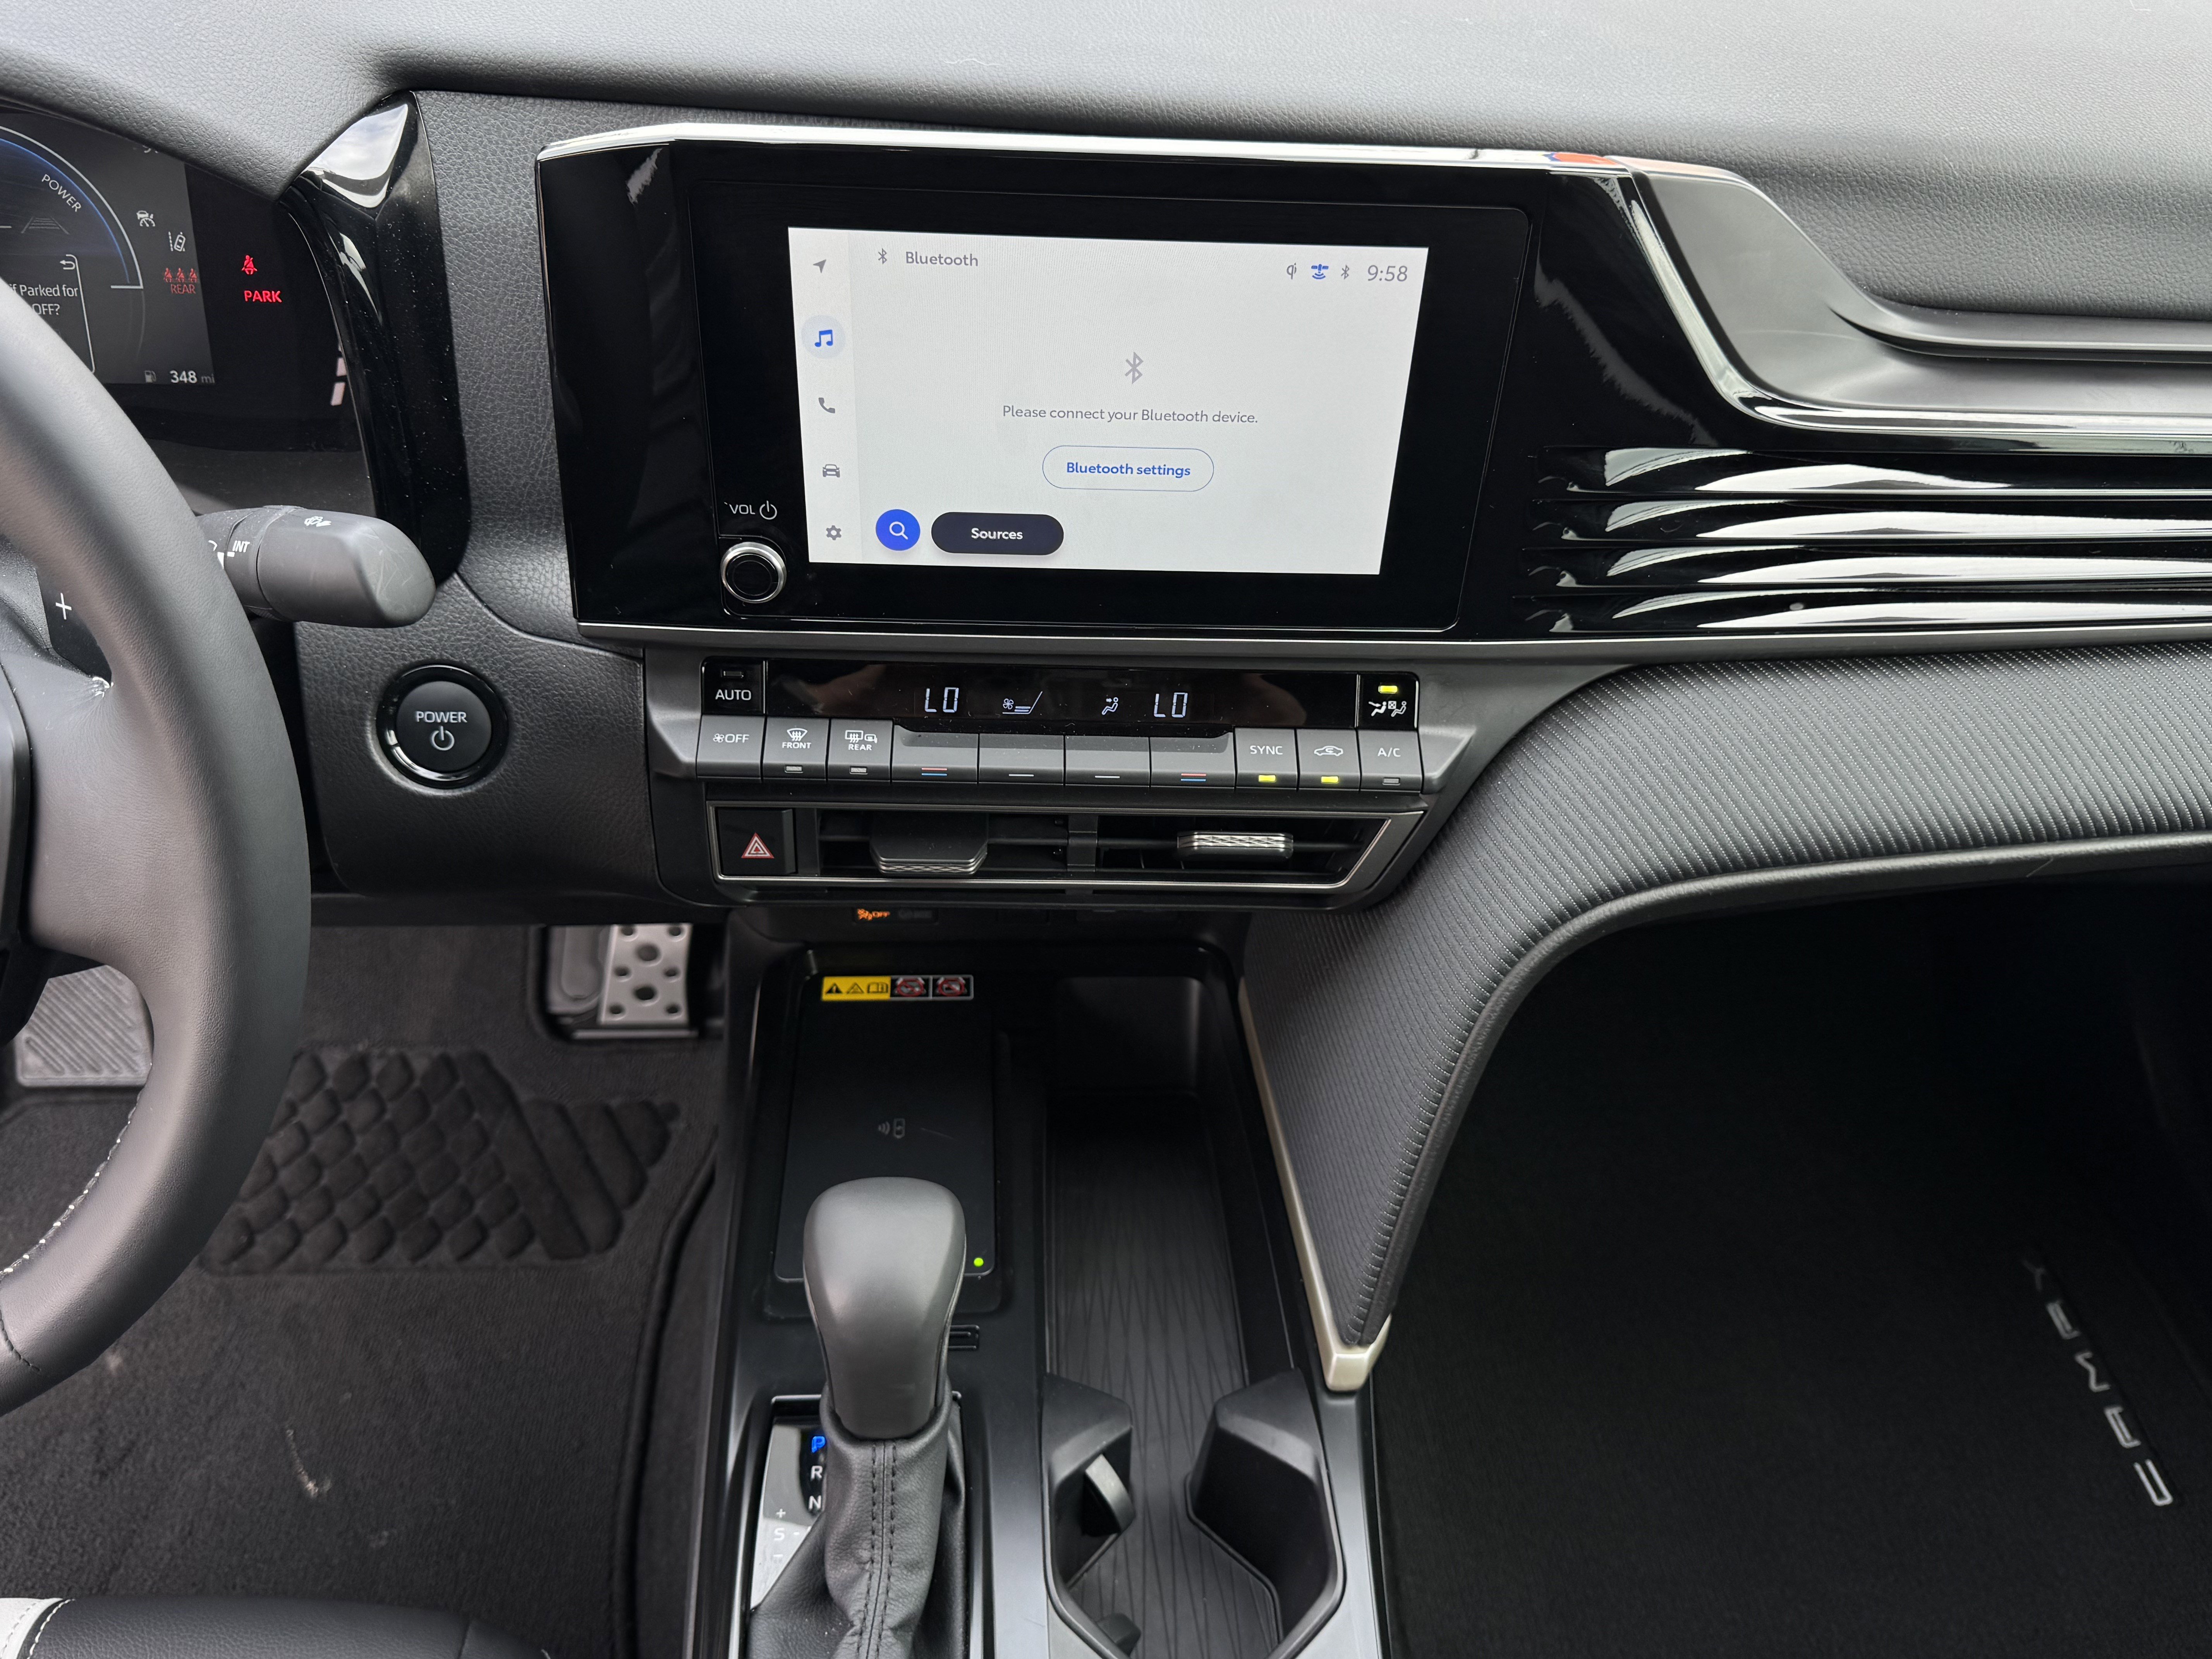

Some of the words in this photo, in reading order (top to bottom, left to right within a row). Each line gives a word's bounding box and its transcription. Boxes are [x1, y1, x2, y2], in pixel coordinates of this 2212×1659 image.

[41, 174, 81, 212] POWER
[906, 251, 978, 266] Bluetooth
[1367, 264, 1408, 282] 9:58
[19, 284, 60, 296] Parked
[62, 284, 78, 297] for
[171, 284, 196, 294] REAR
[244, 290, 282, 302] PARK
[170, 370, 197, 383] 348
[201, 373, 215, 383] mi
[1003, 405, 1046, 417] Please
[1049, 409, 1105, 419] connect
[1107, 411, 1138, 422] your
[1142, 409, 1208, 422] Bluetooth
[1212, 410, 1258, 423] device.
[1067, 462, 1133, 474] Bluetooth
[1136, 464, 1190, 478] settings
[729, 504, 756, 515] VOL
[971, 527, 1023, 539] Sources
[232, 540, 250, 553] INT
[715, 689, 751, 701] AUTO
[416, 711, 467, 723] POWER
[725, 734, 749, 743] OFF
[1250, 745, 1283, 755] SYNC
[1377, 747, 1401, 757] A/C
[2021, 1260, 2173, 1506] CAMRY
[811, 1436, 826, 1453] P
[811, 1465, 823, 1479] R
[809, 1496, 821, 1509] N
[774, 1528, 785, 1540] S
